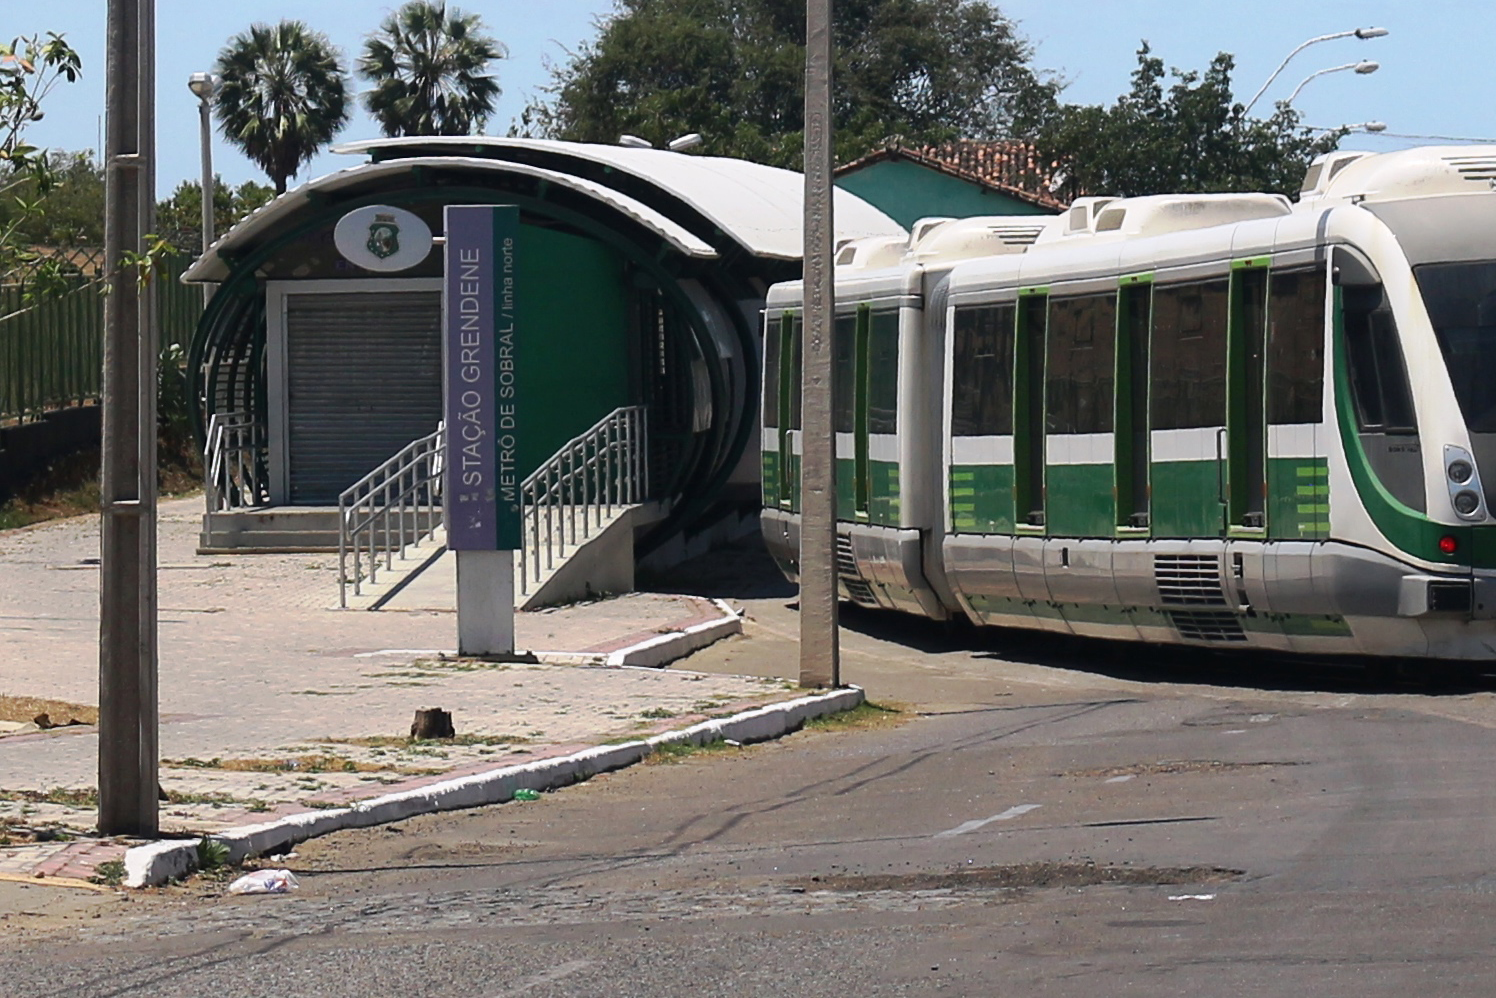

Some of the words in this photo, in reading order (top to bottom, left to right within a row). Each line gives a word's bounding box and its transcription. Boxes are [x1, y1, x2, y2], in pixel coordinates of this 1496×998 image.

[501, 237, 513, 274] norte
[460, 248, 480, 383] GRENDENE
[501, 277, 513, 310] linha
[499, 322, 515, 398] SOBRAL
[500, 404, 515, 429] DE
[497, 434, 516, 502] METRÔ
